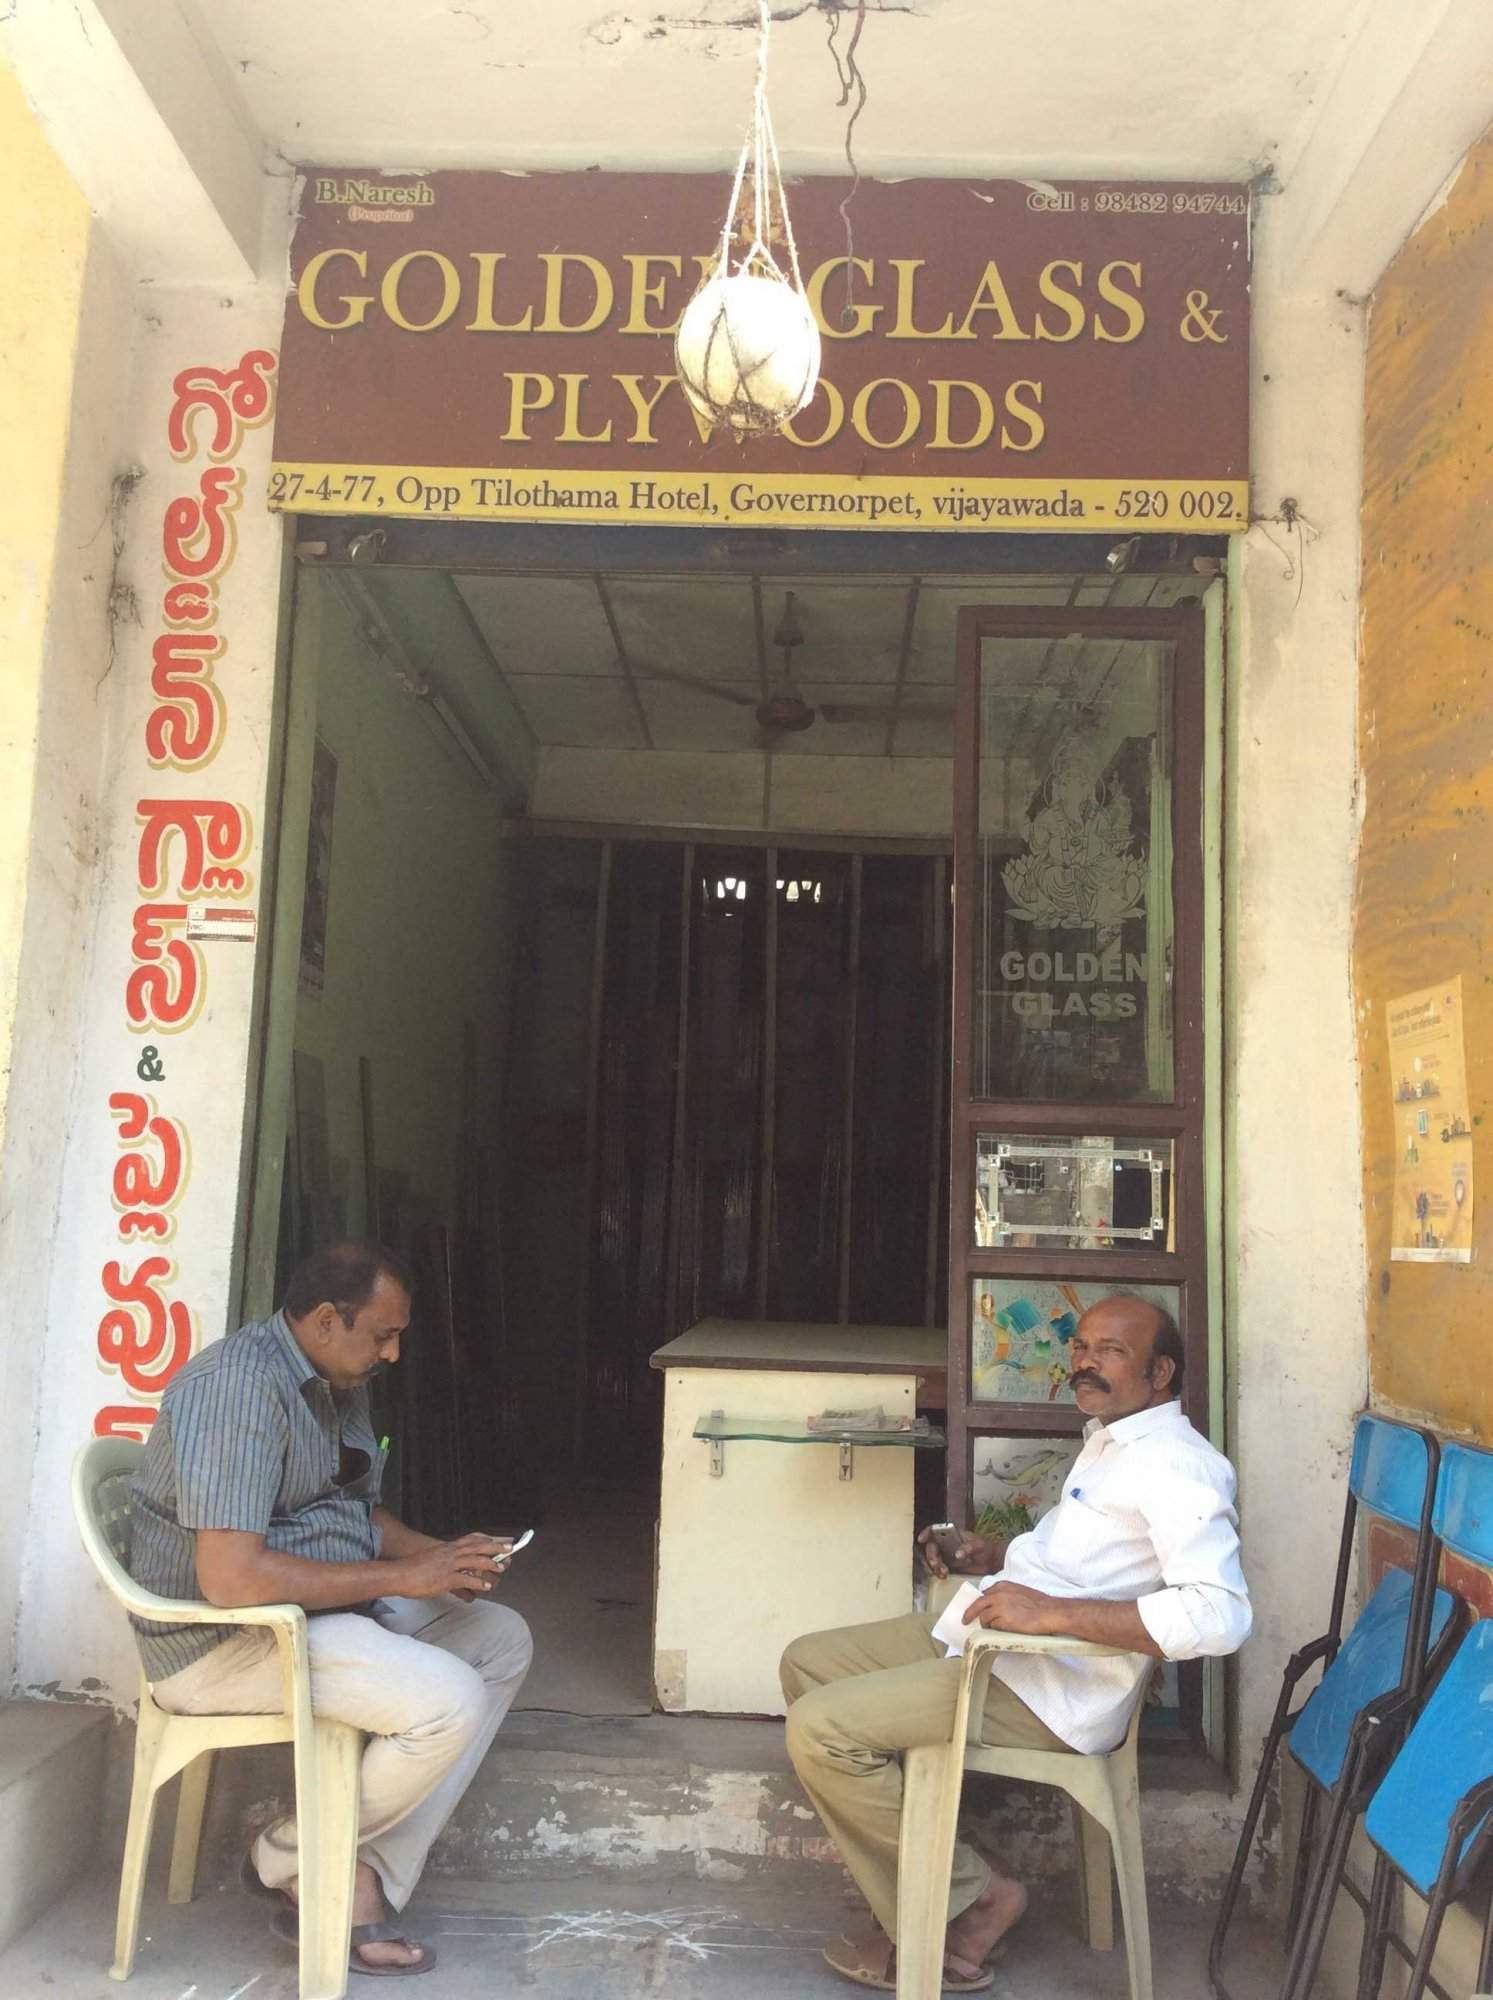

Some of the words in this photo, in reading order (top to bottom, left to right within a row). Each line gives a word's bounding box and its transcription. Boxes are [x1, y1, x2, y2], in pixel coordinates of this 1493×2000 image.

[316, 179, 434, 206] B.Naresh
[1027, 192, 1074, 212] Cell
[1095, 192, 1167, 213] 98482
[806, 256, 1146, 343] GLASS
[1180, 289, 1229, 345] &
[501, 371, 1046, 453] PLYOODS
[268, 471, 384, 508] 27-4-77,
[397, 475, 460, 511] Opp
[471, 478, 619, 510] Tilothama
[629, 481, 718, 514] Hotel,
[731, 484, 922, 520] Governorpet,
[933, 488, 1085, 522] vijayawada
[1114, 491, 1168, 519] 520
[1179, 490, 1242, 521] 002.
[1000, 951, 1150, 983] GOLDEN
[1011, 991, 1138, 1018] GLASS
[137, 1045, 166, 1082] &
